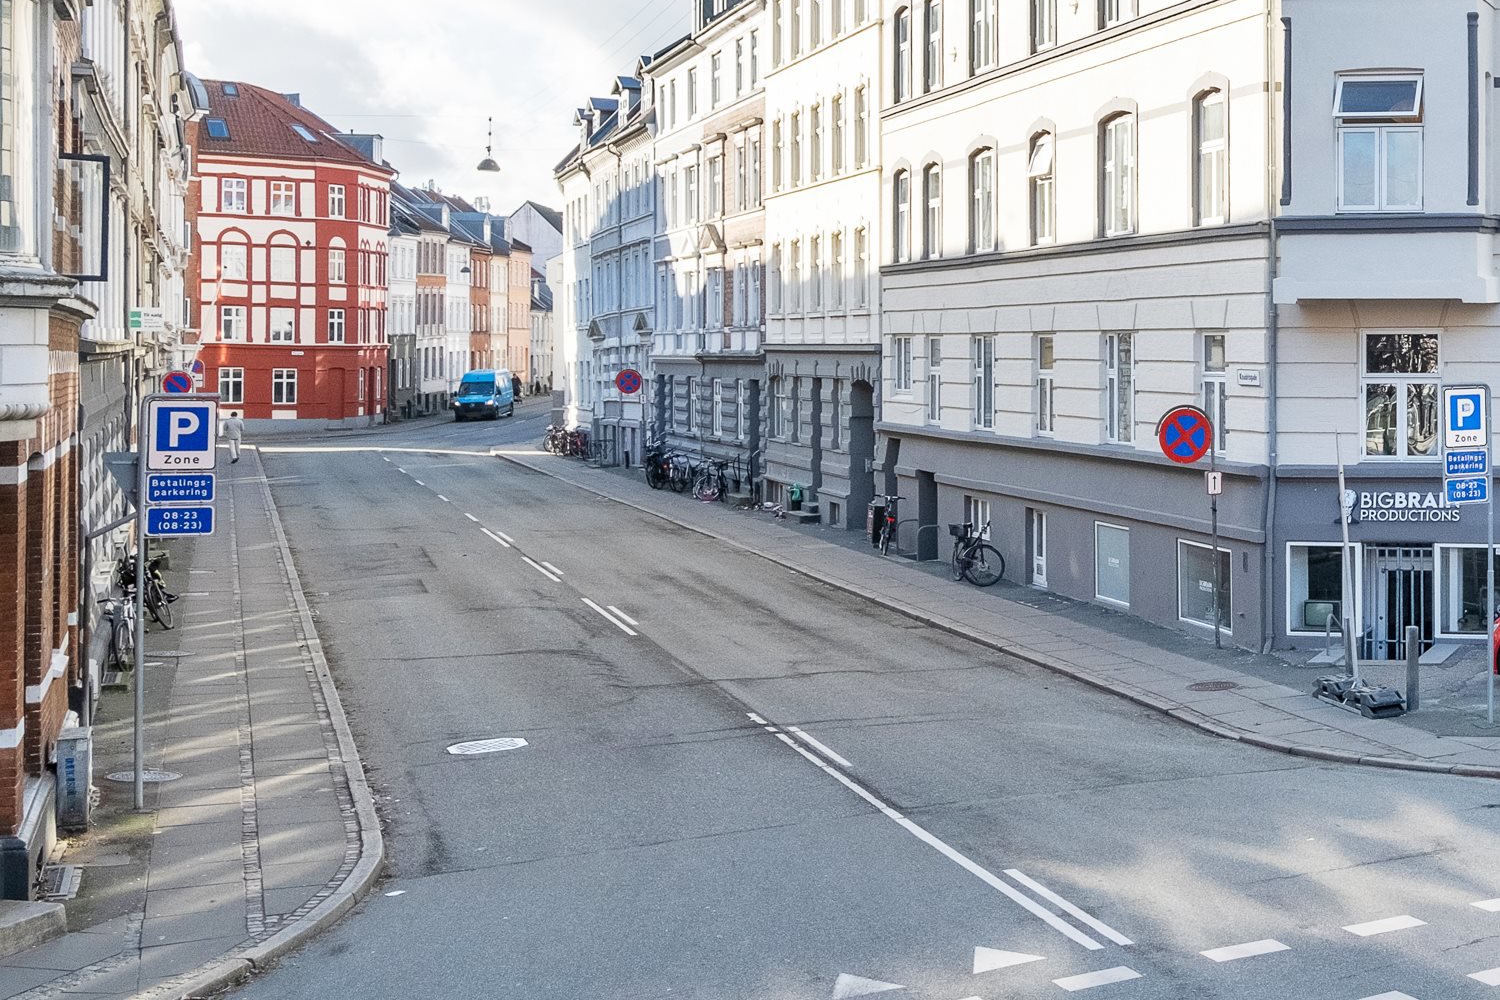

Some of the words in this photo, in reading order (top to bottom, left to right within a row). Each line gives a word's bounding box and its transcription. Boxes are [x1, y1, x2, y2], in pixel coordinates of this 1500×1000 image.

[1457, 398, 1475, 428] P
[169, 411, 200, 448] P
[1455, 434, 1478, 443] Zone
[163, 455, 200, 464] Zone
[1450, 462, 1483, 470] parkering
[152, 479, 211, 488] Betalings-
[1455, 481, 1478, 490] 08-23
[154, 488, 208, 498] parkering
[1453, 490, 1481, 498] (08-23)
[1360, 492, 1460, 508] BIGBRAI
[163, 511, 198, 520] 08-23
[1360, 509, 1460, 521] PRODUCTIONS
[158, 521, 202, 531] (08-23)
